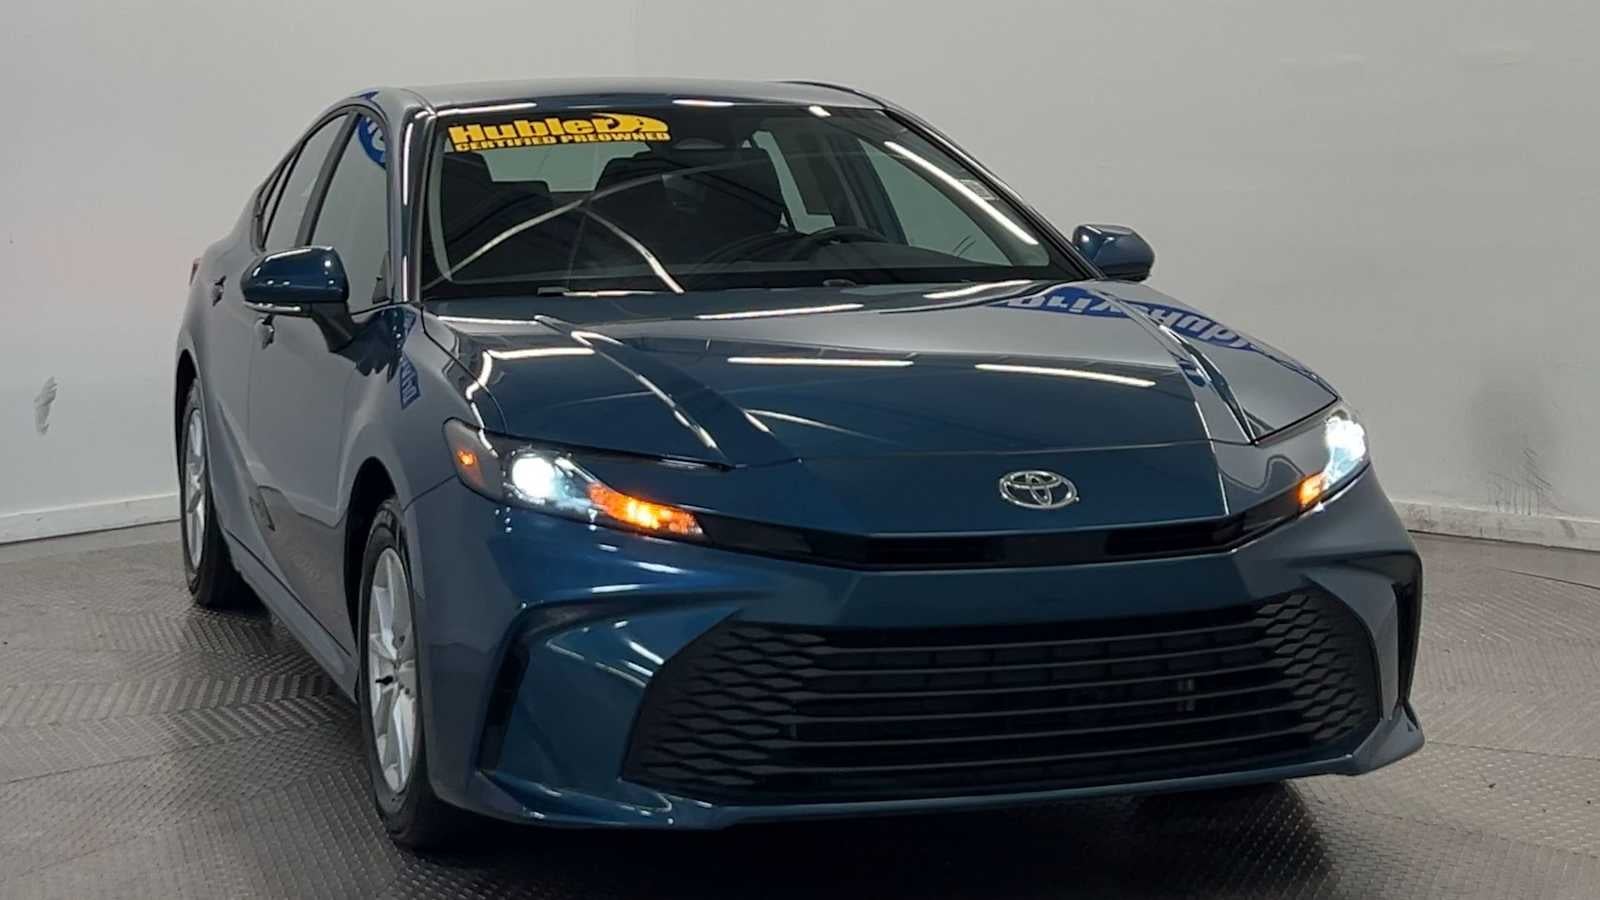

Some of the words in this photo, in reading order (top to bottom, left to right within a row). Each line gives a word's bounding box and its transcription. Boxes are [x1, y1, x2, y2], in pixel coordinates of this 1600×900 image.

[448, 116, 624, 144] Hubler
[455, 135, 558, 152] CERTIFIED
[559, 131, 671, 143] PREOWNED
